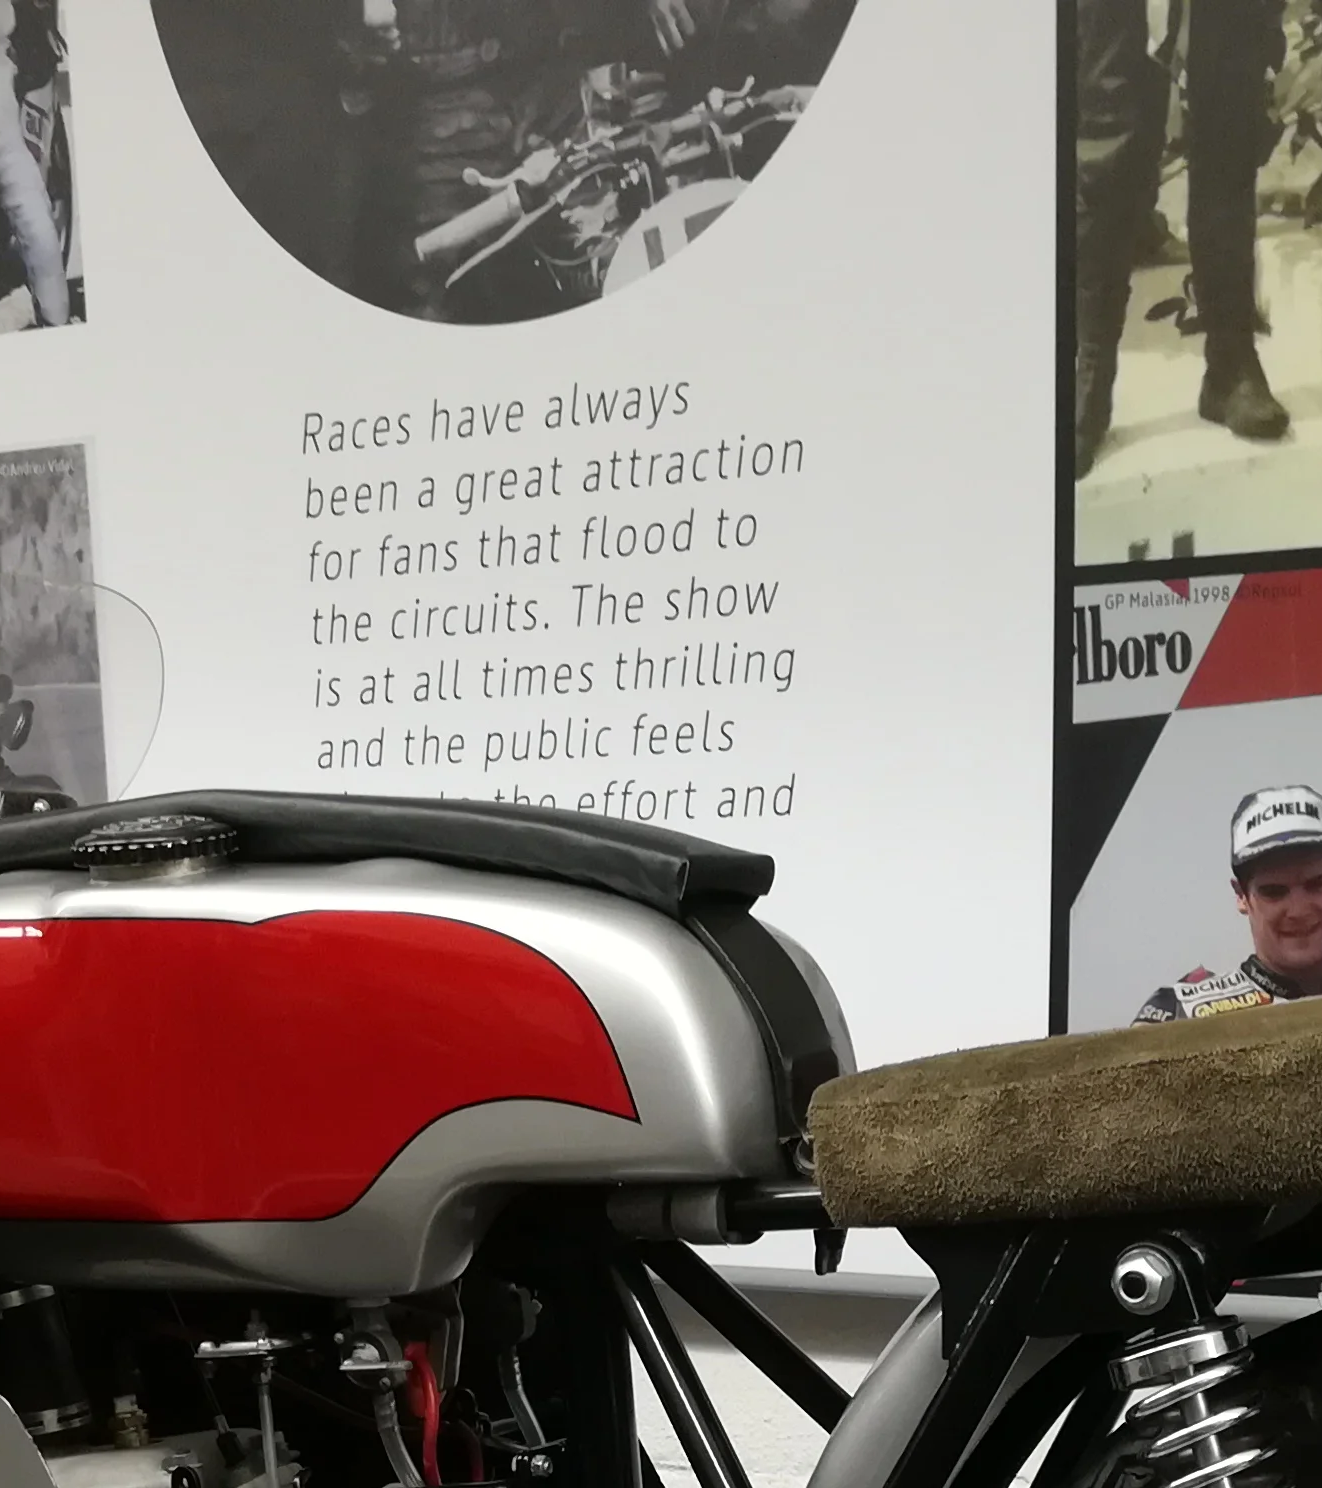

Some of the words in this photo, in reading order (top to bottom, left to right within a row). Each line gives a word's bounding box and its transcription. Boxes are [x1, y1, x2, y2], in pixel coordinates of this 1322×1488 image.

[303, 413, 410, 454] Races
[431, 399, 523, 441] have
[545, 382, 689, 430] always
[306, 477, 397, 518] been
[418, 477, 434, 508] a
[456, 457, 563, 515] great
[583, 434, 803, 492] attraction
[309, 540, 361, 582] for
[379, 534, 458, 576] fans
[479, 524, 561, 568] that
[583, 507, 694, 560] flood
[717, 508, 757, 549] to
[313, 604, 371, 645] the
[391, 592, 549, 639] circuits.
[572, 583, 643, 627] The
[665, 576, 779, 621] show
[1104, 593, 1125, 611] GP
[1192, 586, 1231, 605] 1998
[316, 669, 340, 708] is
[360, 667, 395, 705] at
[414, 659, 461, 702] all
[483, 657, 593, 698] times
[616, 642, 795, 692] thrilling
[1073, 603, 1194, 686] lboro
[318, 727, 384, 769] and
[405, 725, 464, 765] the
[484, 717, 611, 772] public
[633, 710, 734, 756] feels
[577, 780, 697, 822] effort
[717, 773, 795, 818] and
[1245, 801, 1322, 835] MICHELIN
